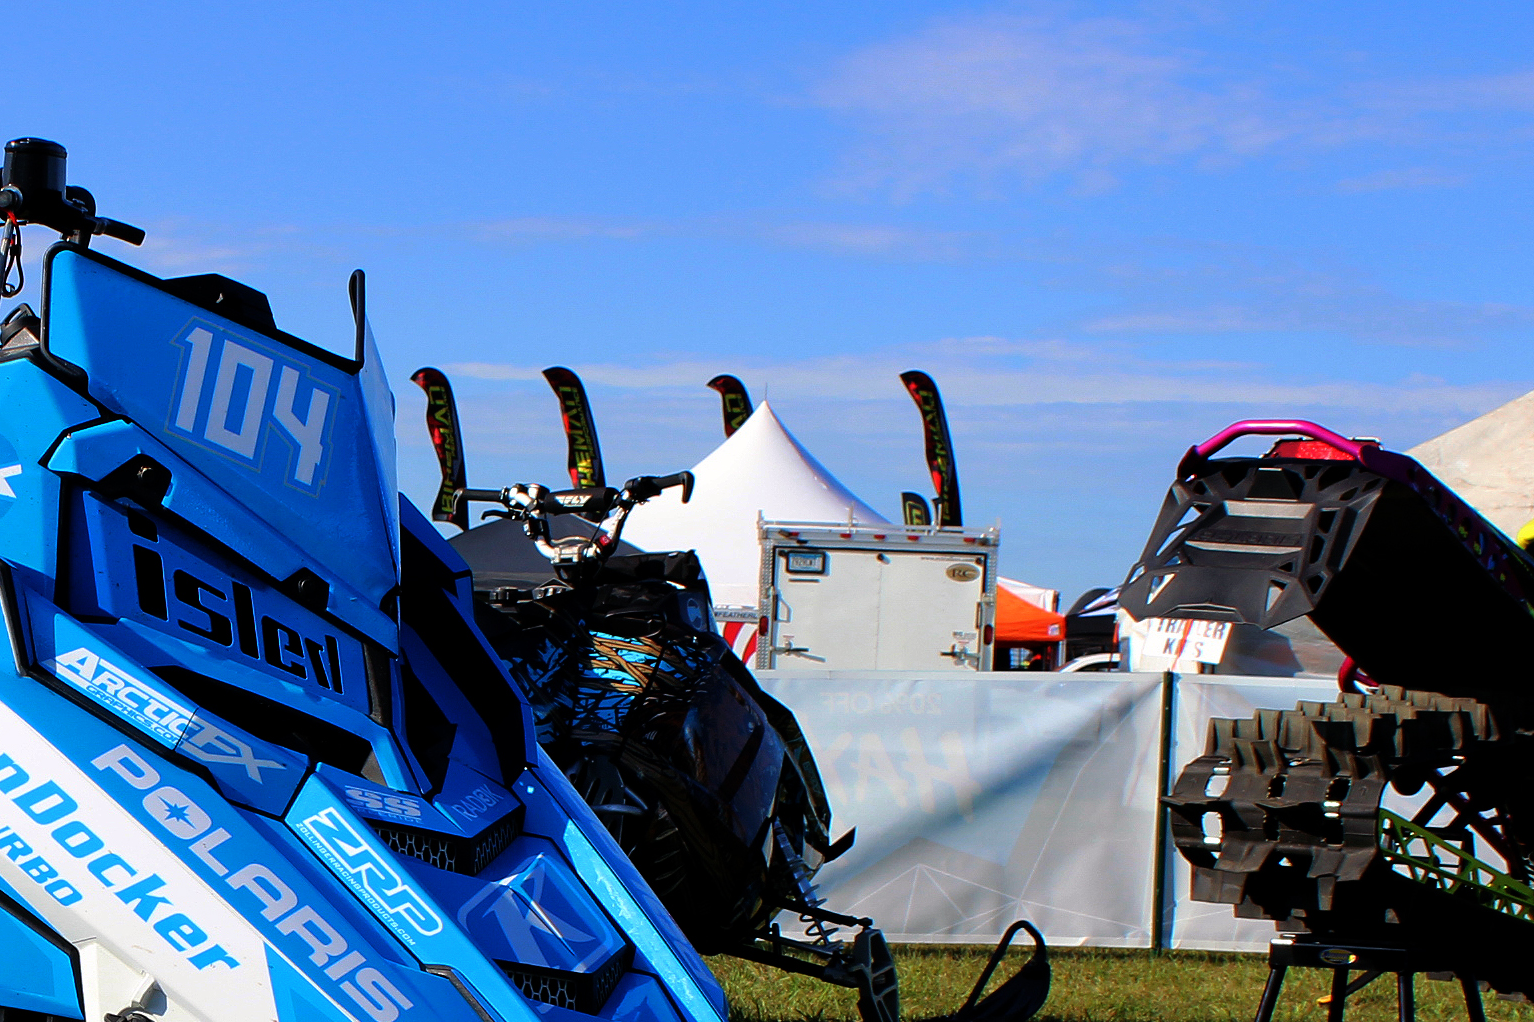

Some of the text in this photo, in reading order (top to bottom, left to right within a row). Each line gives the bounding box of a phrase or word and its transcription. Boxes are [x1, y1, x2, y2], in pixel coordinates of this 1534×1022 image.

[175, 327, 330, 488] 104
[125, 508, 344, 697] isled
[302, 806, 444, 937] ZRP
